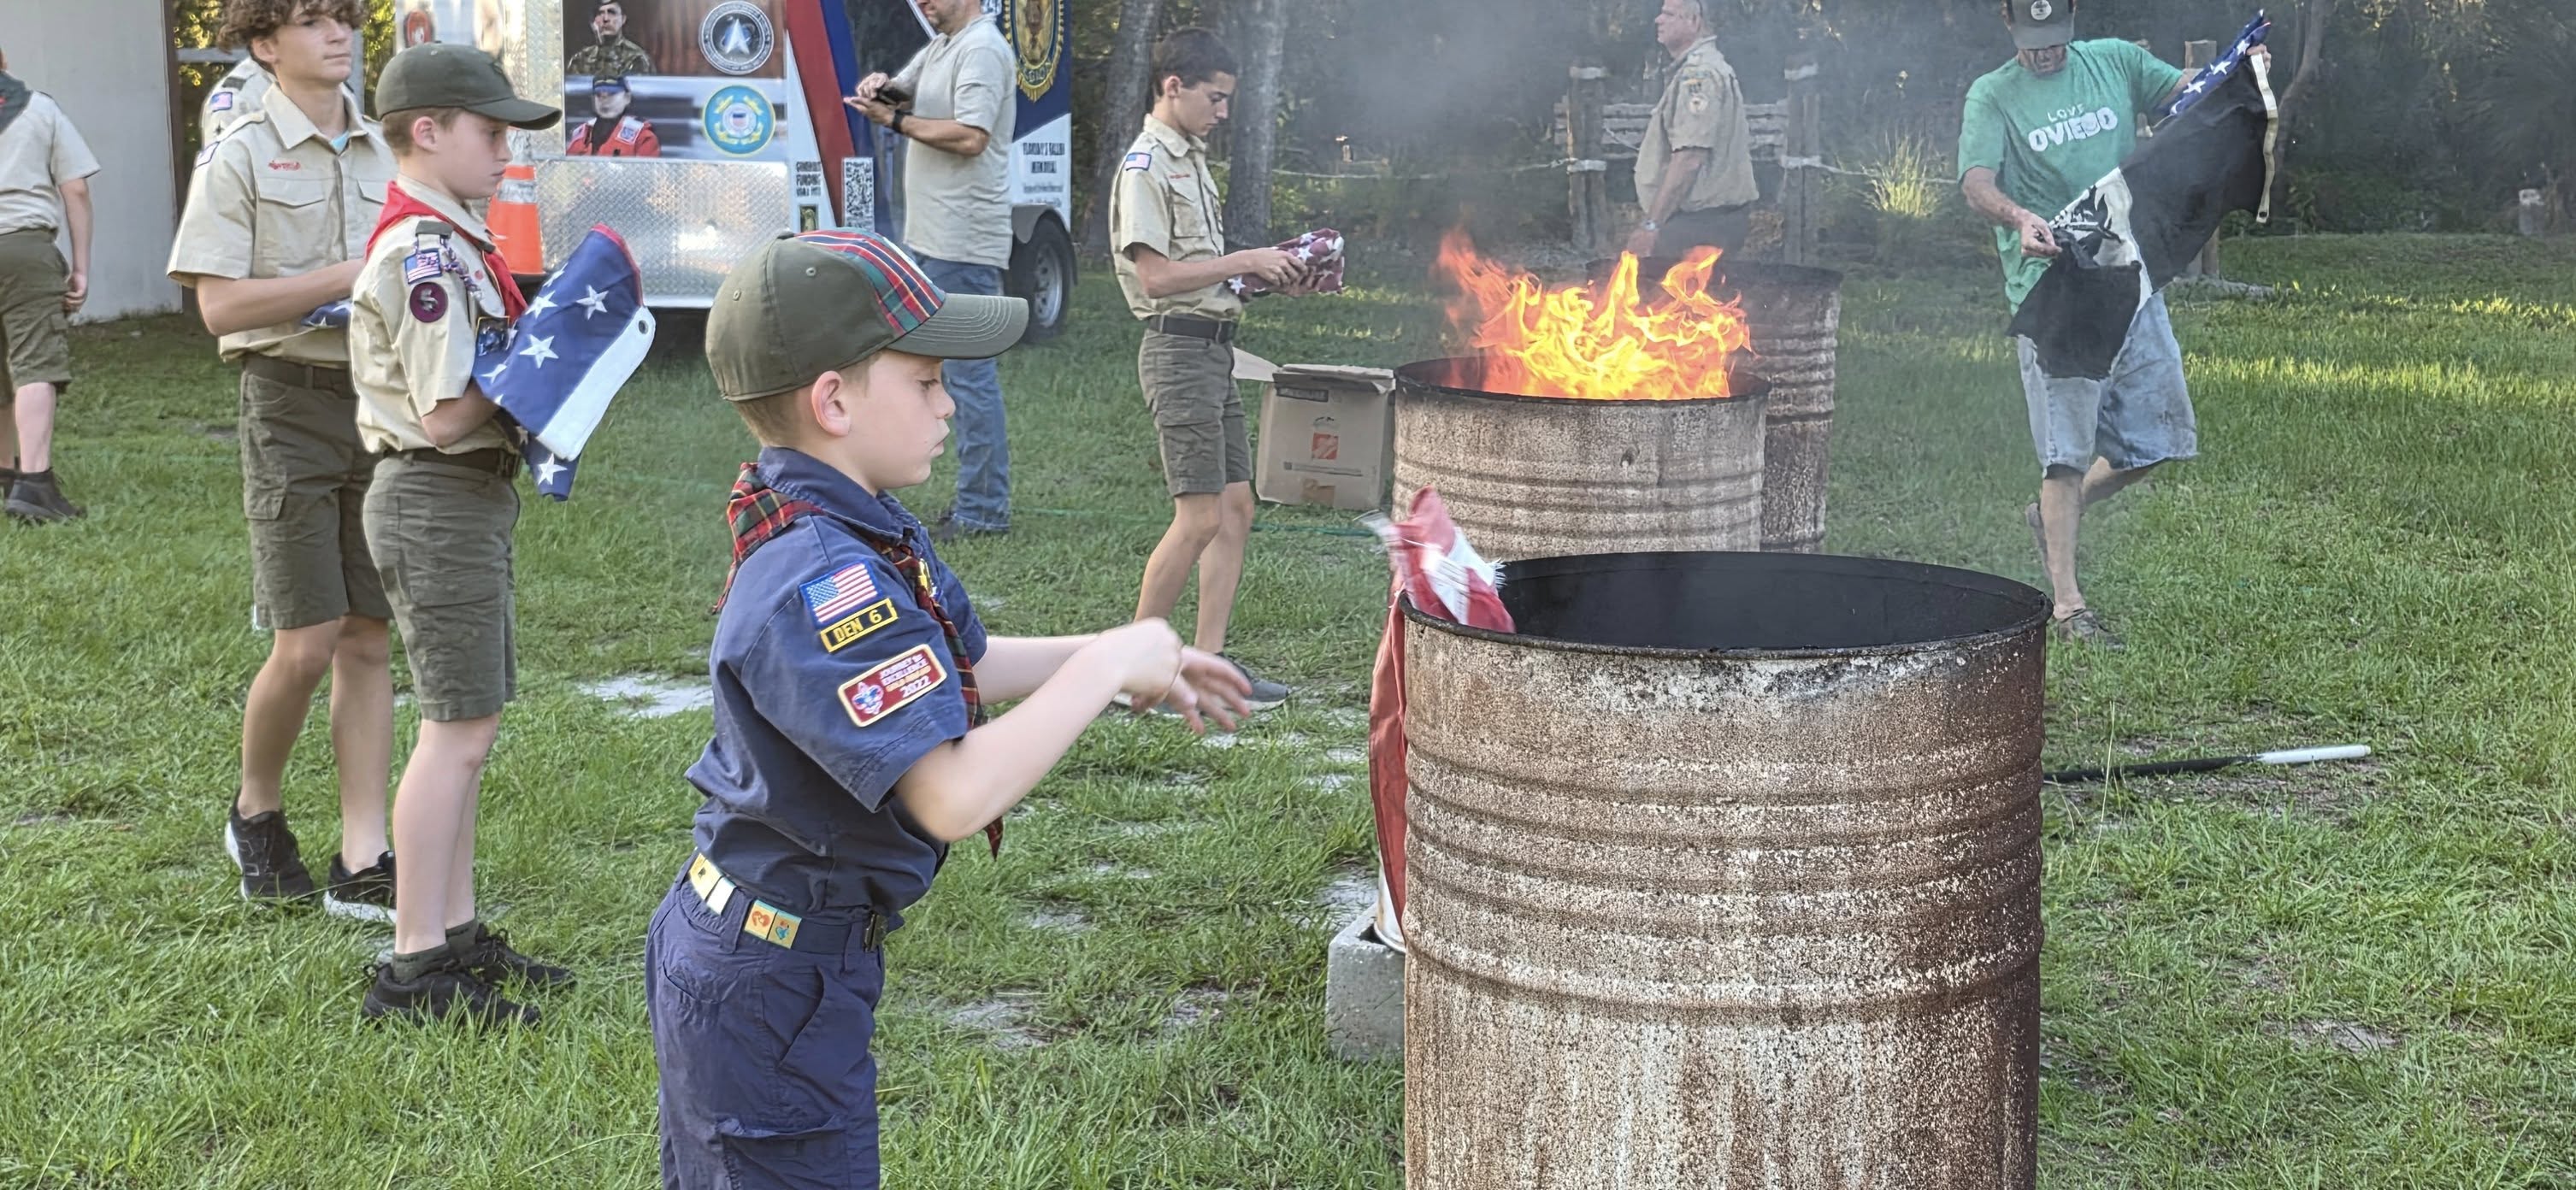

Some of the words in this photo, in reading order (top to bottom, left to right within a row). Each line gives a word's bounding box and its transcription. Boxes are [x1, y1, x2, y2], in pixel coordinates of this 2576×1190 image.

[2047, 103, 2084, 123] LOVE
[2028, 107, 2119, 151] OVIEDO
[833, 617, 864, 642] DEN
[869, 609, 882, 623] 6
[900, 675, 930, 698] 2022
